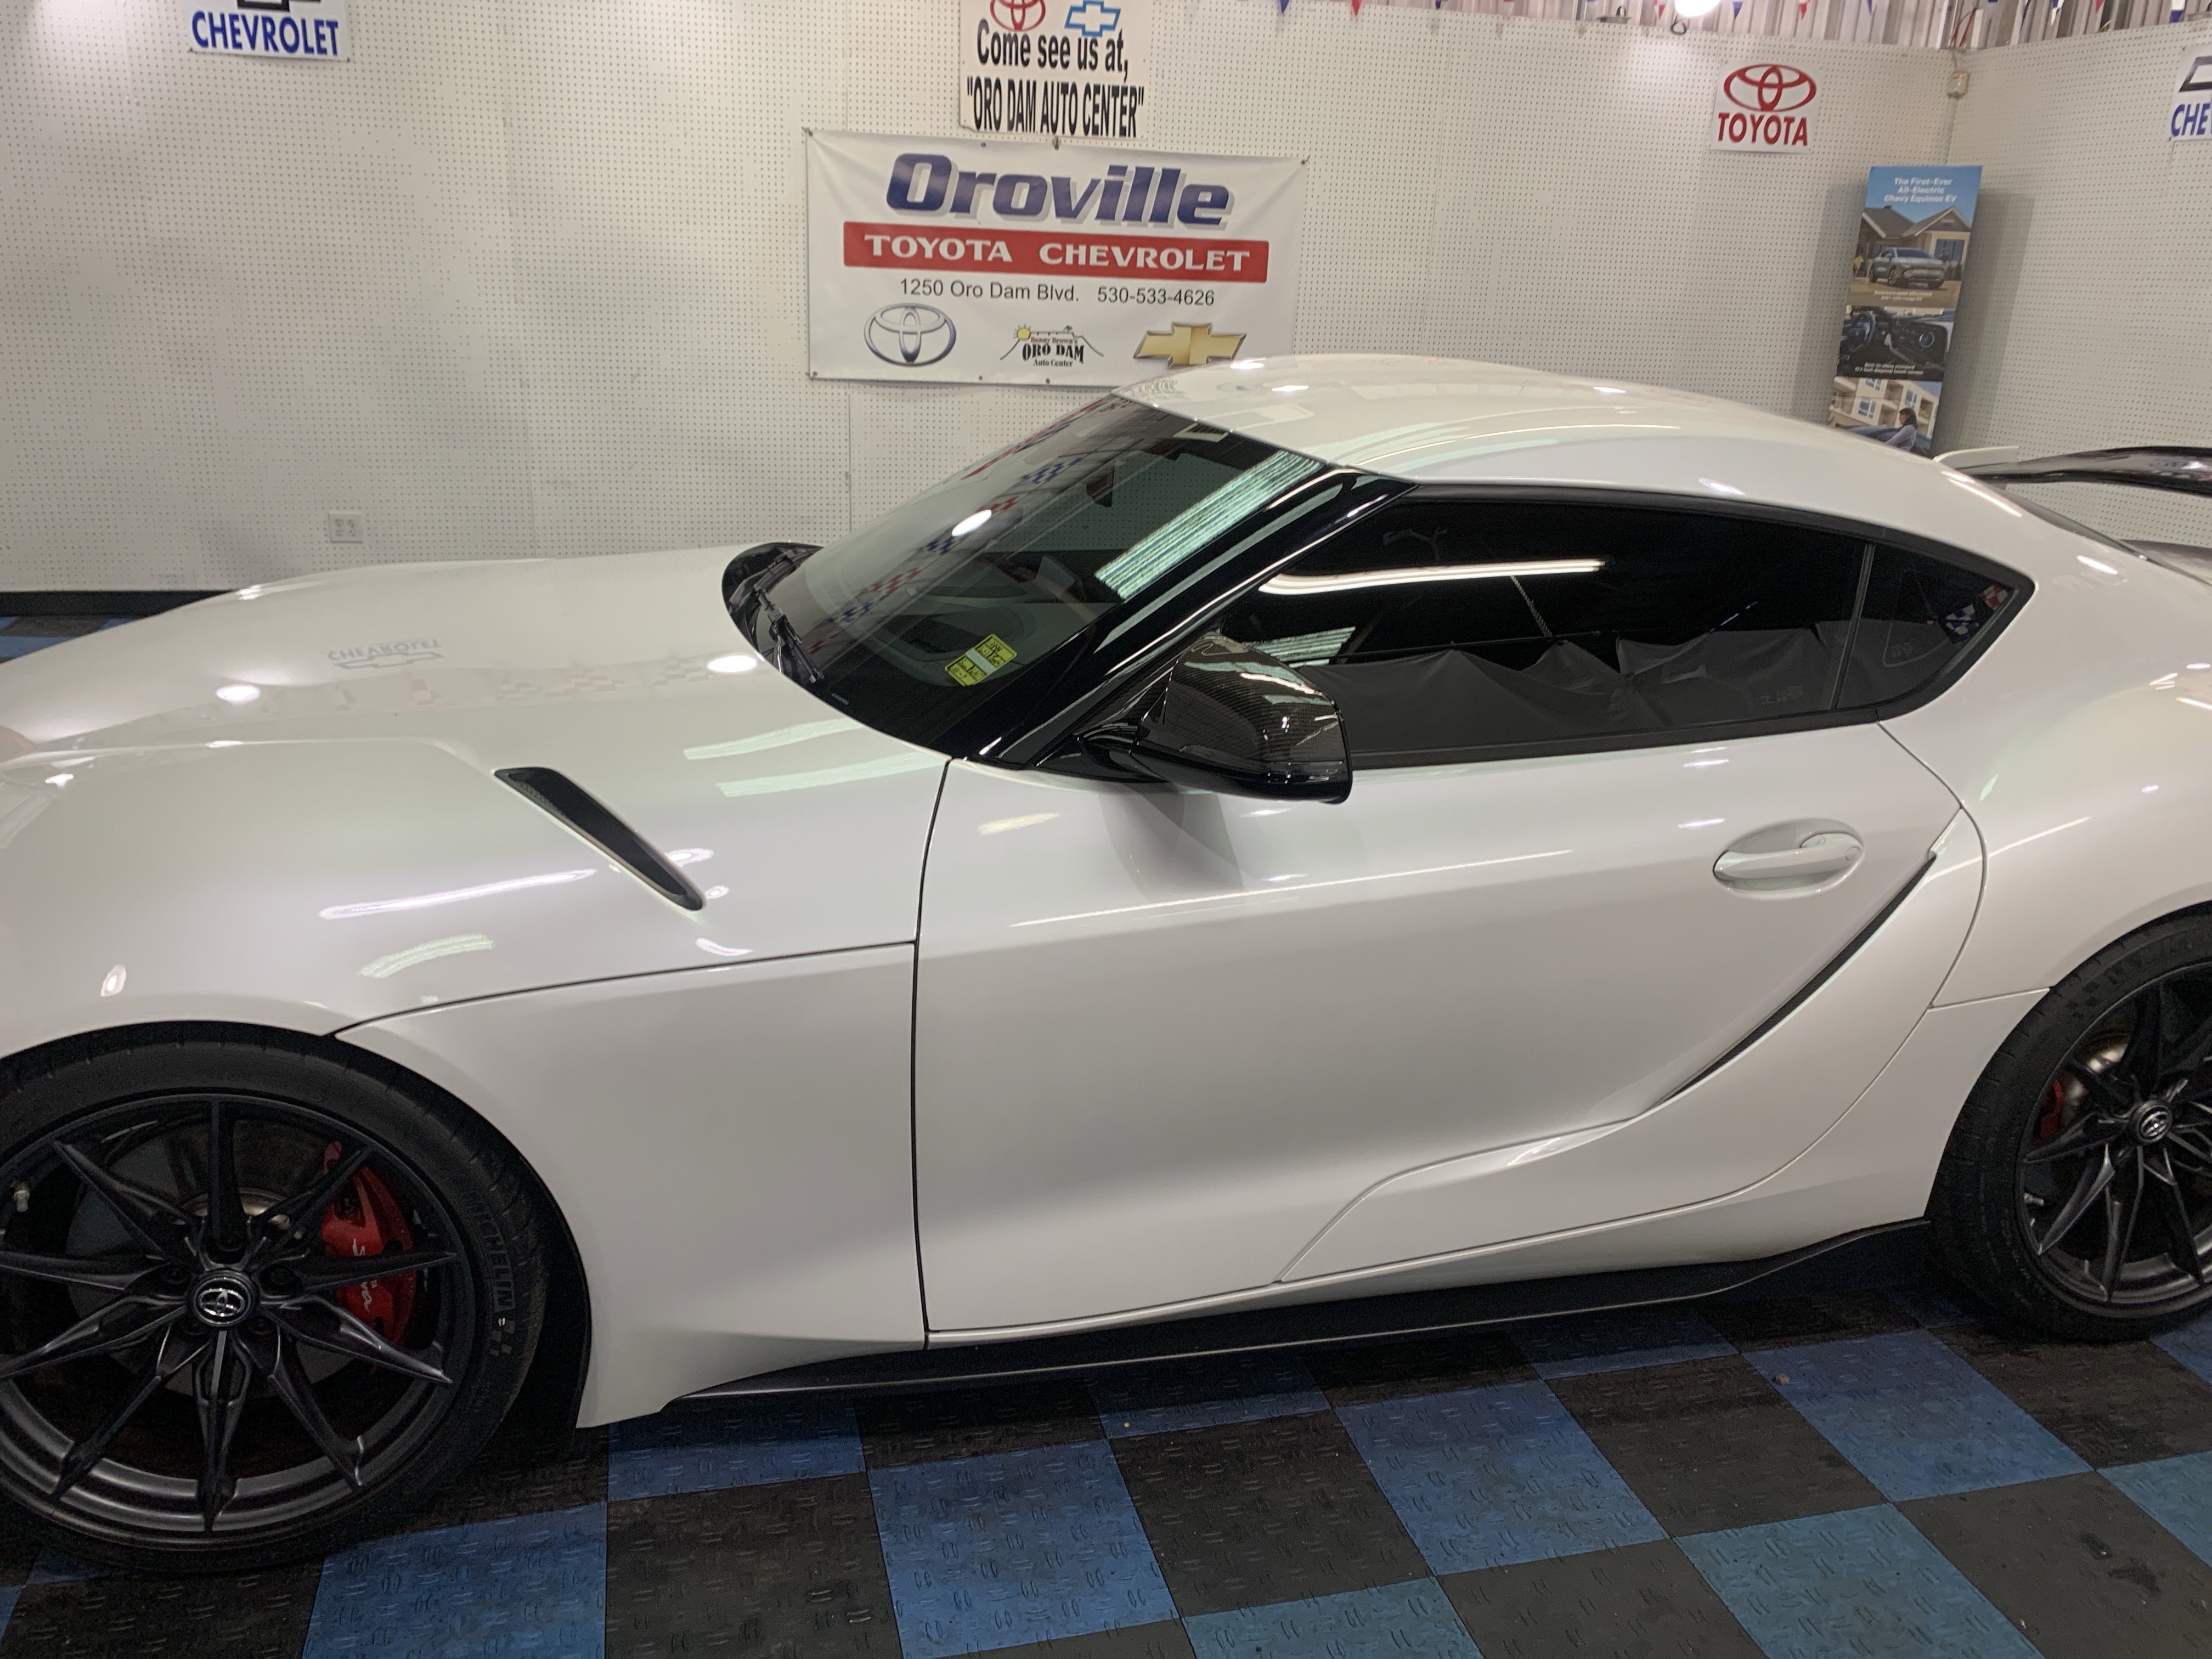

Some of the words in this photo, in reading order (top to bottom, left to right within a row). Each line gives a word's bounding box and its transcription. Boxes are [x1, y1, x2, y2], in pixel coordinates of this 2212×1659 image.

[192, 10, 338, 56] CHEVROLET
[977, 18, 1030, 67] Come
[1037, 34, 1071, 69] see
[1077, 37, 1099, 71] us
[1105, 27, 1128, 83] at,
[967, 75, 1002, 132] "ORO
[1007, 78, 1037, 133] DAM
[1040, 80, 1078, 136] AUTO
[1082, 82, 1144, 138] CENTER"
[2171, 102, 2212, 137] CHE
[1718, 112, 1808, 146] TOYOTA
[885, 152, 1234, 228] Oroville
[1884, 195, 1909, 204] Chevy
[1910, 195, 1944, 203] Equinox
[864, 234, 1012, 263] TOYOTA
[1039, 242, 1250, 272] CHEVROLET
[900, 279, 944, 296] 1250
[950, 280, 983, 298] Oro
[990, 282, 1030, 300] Dam
[1037, 284, 1079, 302] Blvd.
[1097, 286, 1215, 307] 530-533-4626
[1022, 343, 1051, 361] ORO
[1056, 344, 1084, 364] DAM
